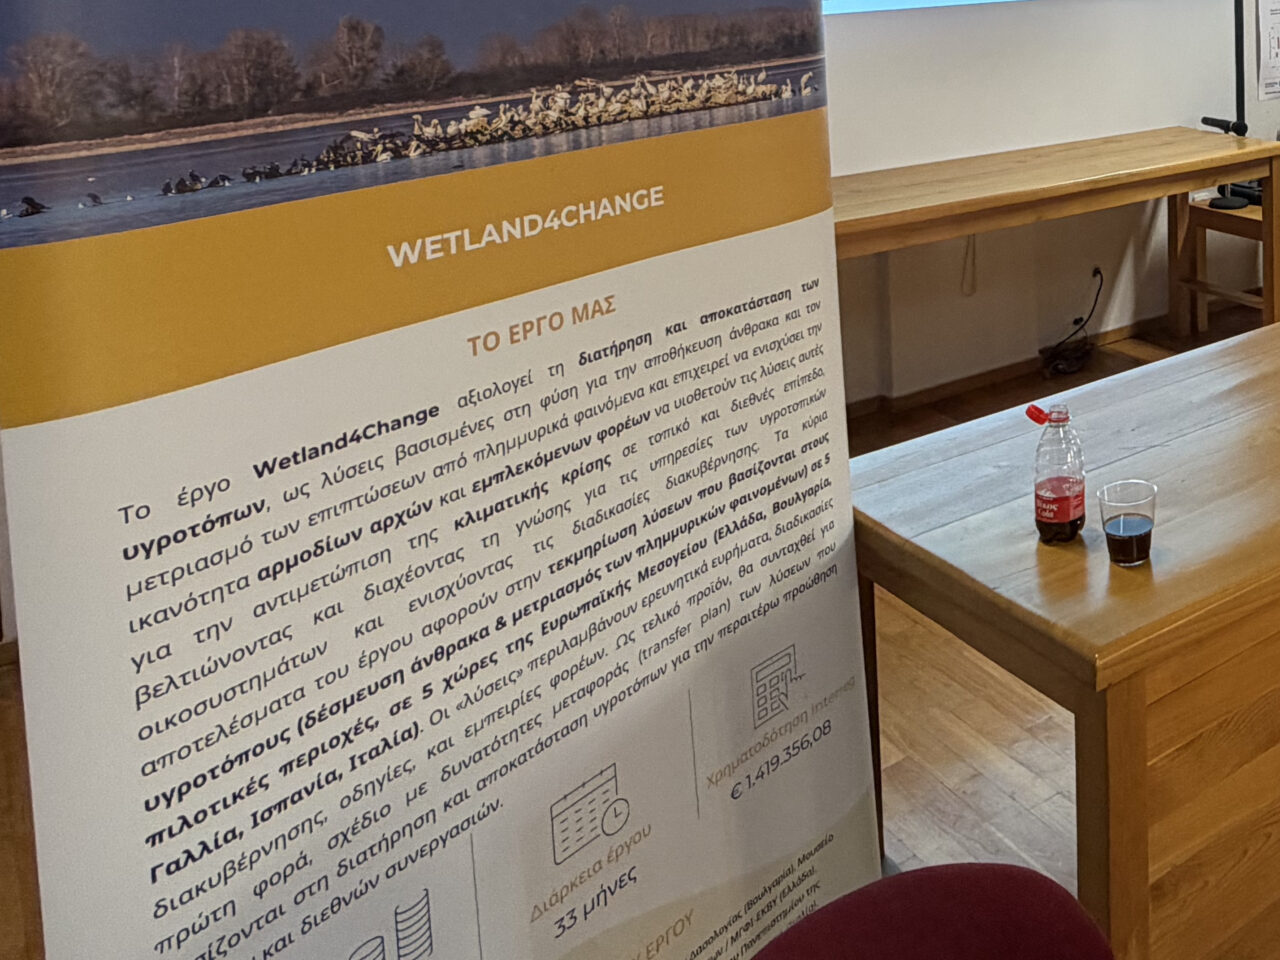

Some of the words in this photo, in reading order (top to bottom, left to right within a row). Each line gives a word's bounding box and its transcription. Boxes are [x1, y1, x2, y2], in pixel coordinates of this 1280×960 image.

[387, 185, 664, 267] WETLAND4CHANGE
[467, 331, 500, 356] ΤΟ
[509, 312, 564, 345] ΕΡΓΟ
[572, 295, 616, 325] ΜΑΣ
[117, 504, 151, 524] Το
[177, 478, 231, 508] έργο
[252, 405, 440, 479] Wetland4Change
[457, 369, 534, 409] αξιολογεί
[547, 363, 565, 377] τη
[578, 332, 652, 366] διατήρηση
[665, 321, 688, 337] και
[699, 289, 792, 325] αποκατάσταση
[801, 278, 819, 293] των
[131, 643, 173, 675] για
[193, 616, 233, 644] την
[253, 548, 392, 618] αντιμετώπιση
[407, 528, 439, 550] της
[454, 481, 549, 531] κλιματικής
[561, 454, 612, 485] κρίσης
[622, 442, 638, 458] σε
[648, 417, 690, 446] τοπικό
[701, 409, 720, 424] και
[730, 387, 775, 412] διεθνές
[144, 727, 291, 812] υγροτόπους
[297, 669, 405, 737] (δέσμευση
[410, 625, 490, 674] άνθρακα
[494, 615, 507, 632] &
[512, 567, 602, 627] μετριασμός
[605, 551, 633, 573] των
[635, 504, 726, 557] πλημμυρικών
[729, 464, 808, 513] φαινομένων)
[810, 458, 823, 472] σε
[824, 452, 830, 465] 5
[145, 773, 270, 848] πιλοτικές
[278, 715, 380, 777] περιοχές,
[389, 695, 413, 717] σε
[422, 682, 433, 700] 5
[442, 651, 498, 695] χώρες
[505, 631, 534, 655] της
[541, 579, 632, 637] Ευρωπαϊκής
[637, 538, 708, 584] Μεσογείου
[713, 511, 767, 545] (Ελλάδα,
[772, 478, 832, 515] Βουλγαρία,
[706, 710, 809, 790] Χρηματοδότηση
[730, 781, 743, 800] €
[745, 719, 832, 790] 1.419.356,08
[261, 933, 295, 960] και
[300, 874, 380, 936] διεθνών
[385, 798, 503, 879] συνεργασιών.
[530, 859, 603, 924] Διάρκεια
[607, 824, 651, 864] έργου
[797, 833, 834, 868] Μουσείο
[553, 907, 578, 939] 33
[583, 865, 637, 921] μήνες
[644, 908, 694, 960] ΕΡΓΟΥ
